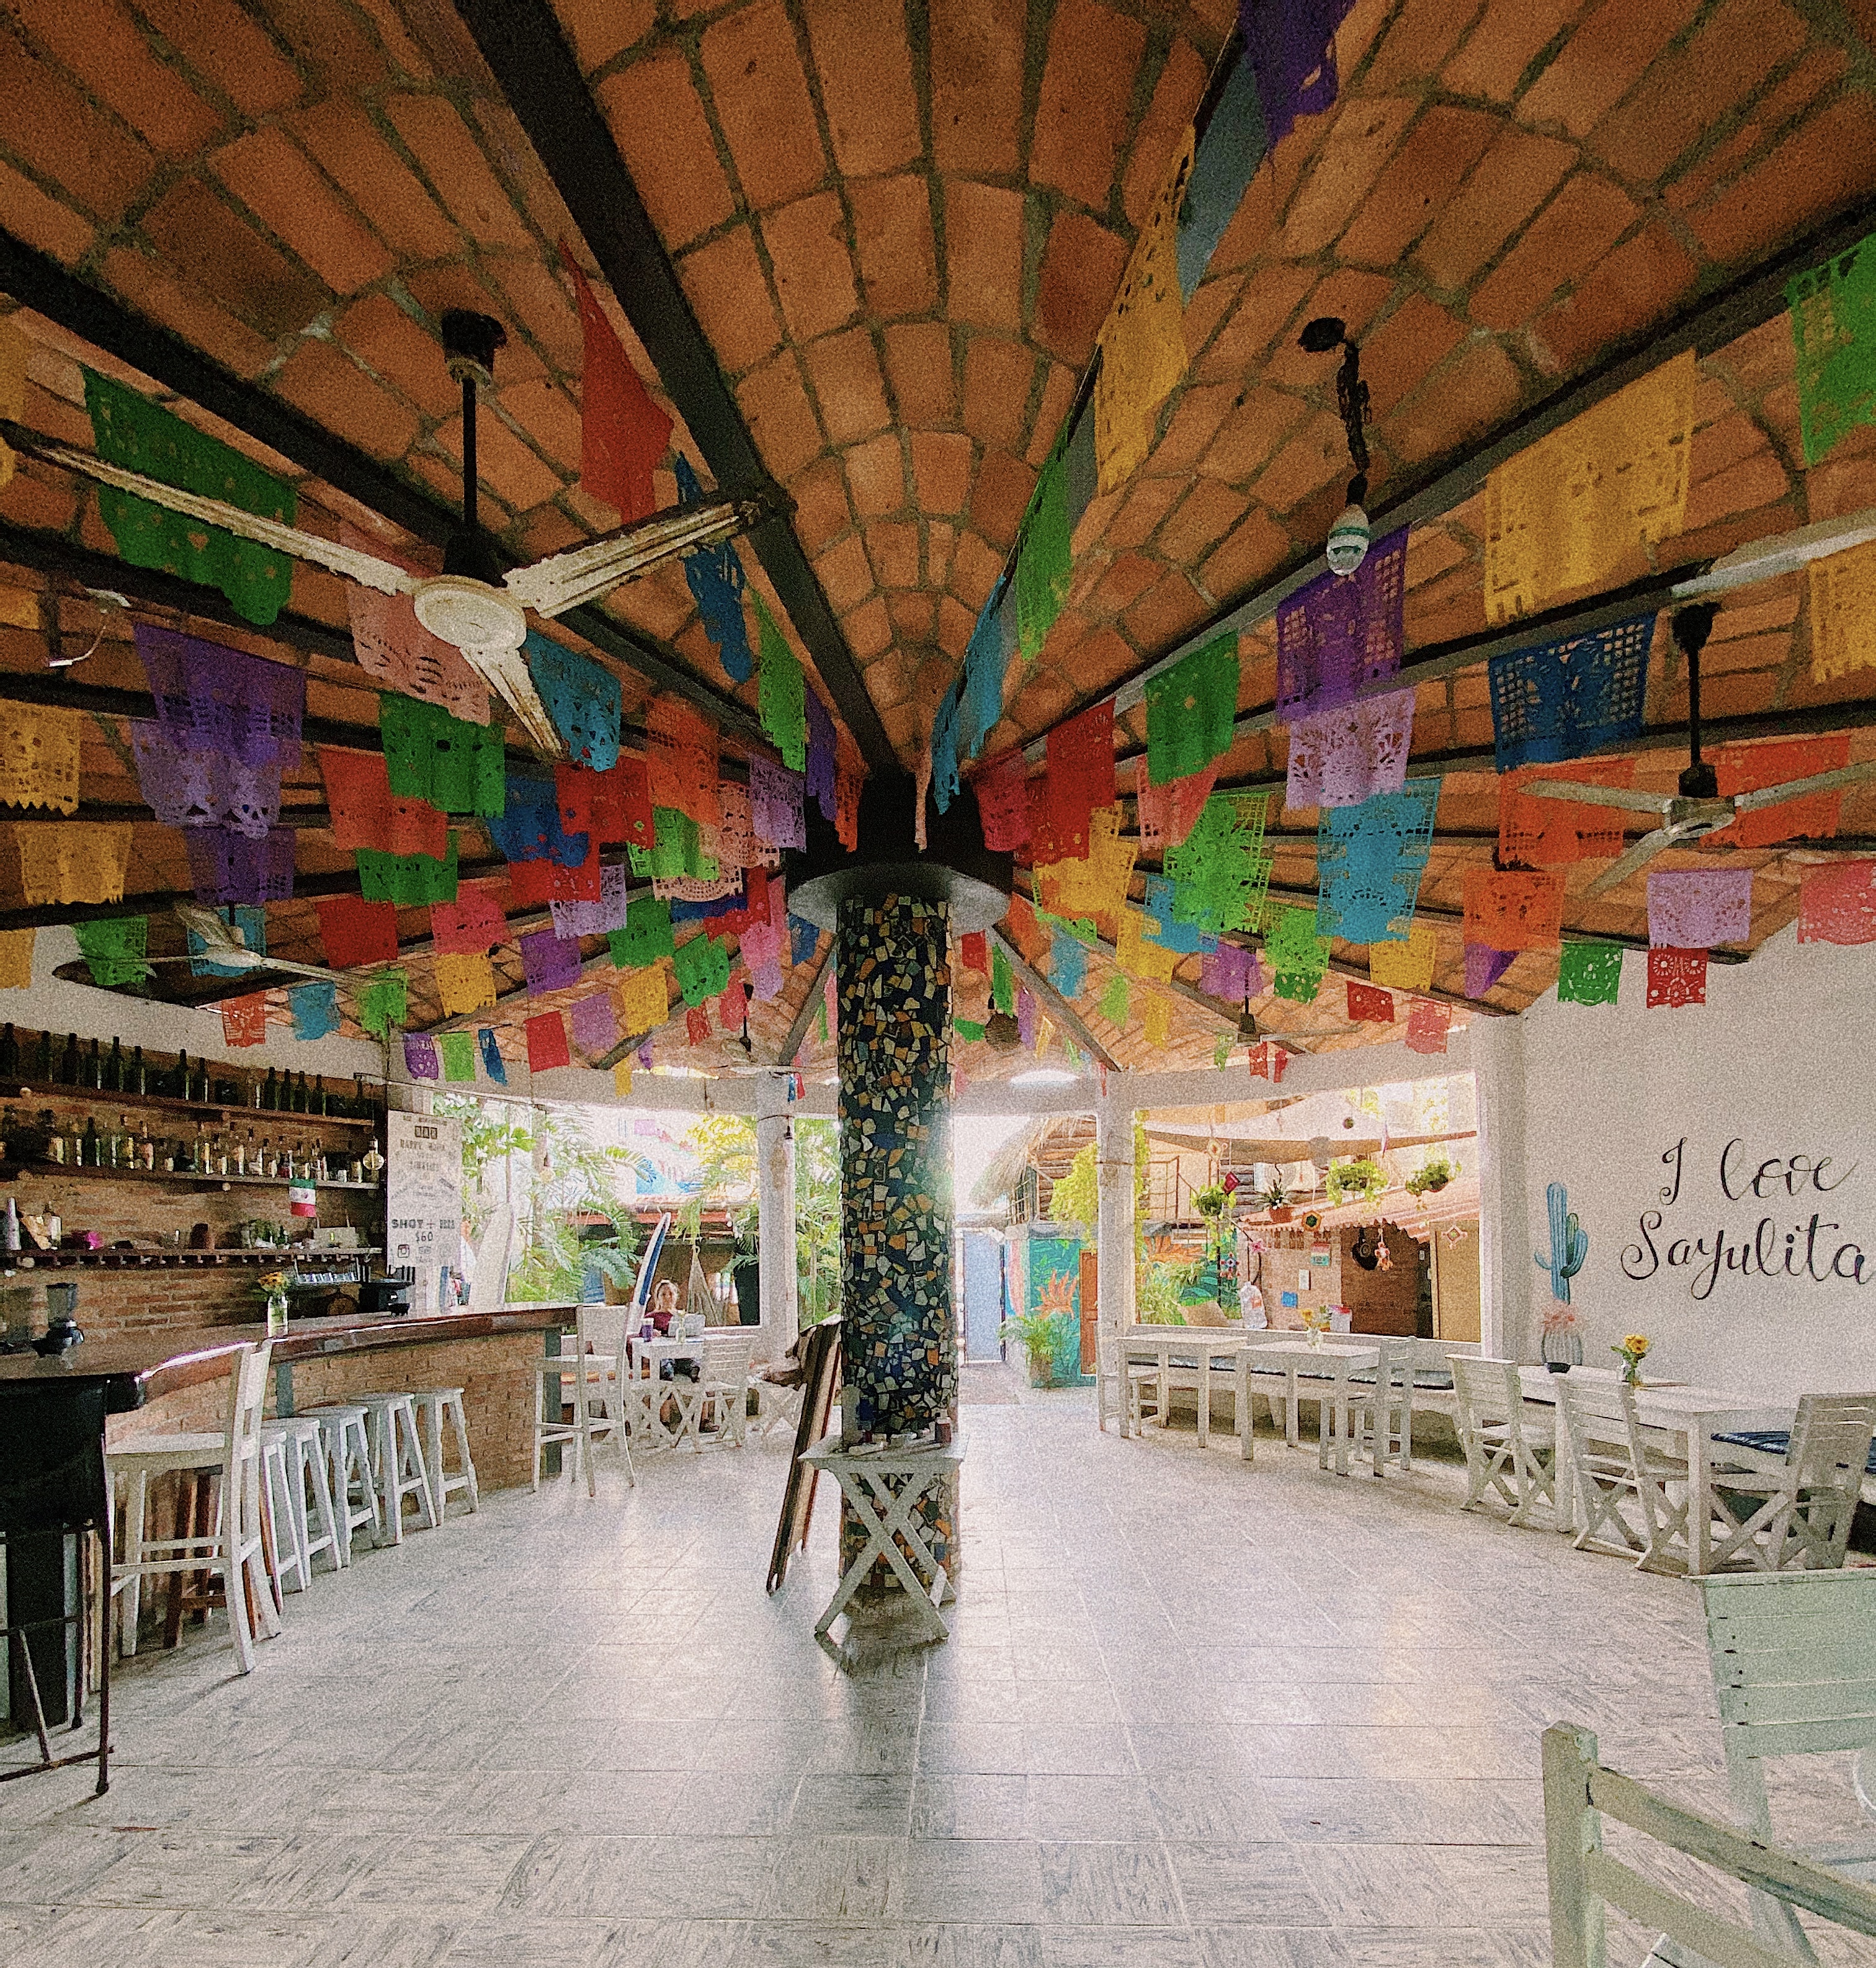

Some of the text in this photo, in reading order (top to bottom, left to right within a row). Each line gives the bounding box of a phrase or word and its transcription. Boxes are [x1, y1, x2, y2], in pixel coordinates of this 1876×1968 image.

[1659, 1137, 1857, 1205] I love
[391, 1219, 423, 1228] SHOT
[415, 1230, 433, 1244] $60
[1620, 1210, 1875, 1300] Sayulita
